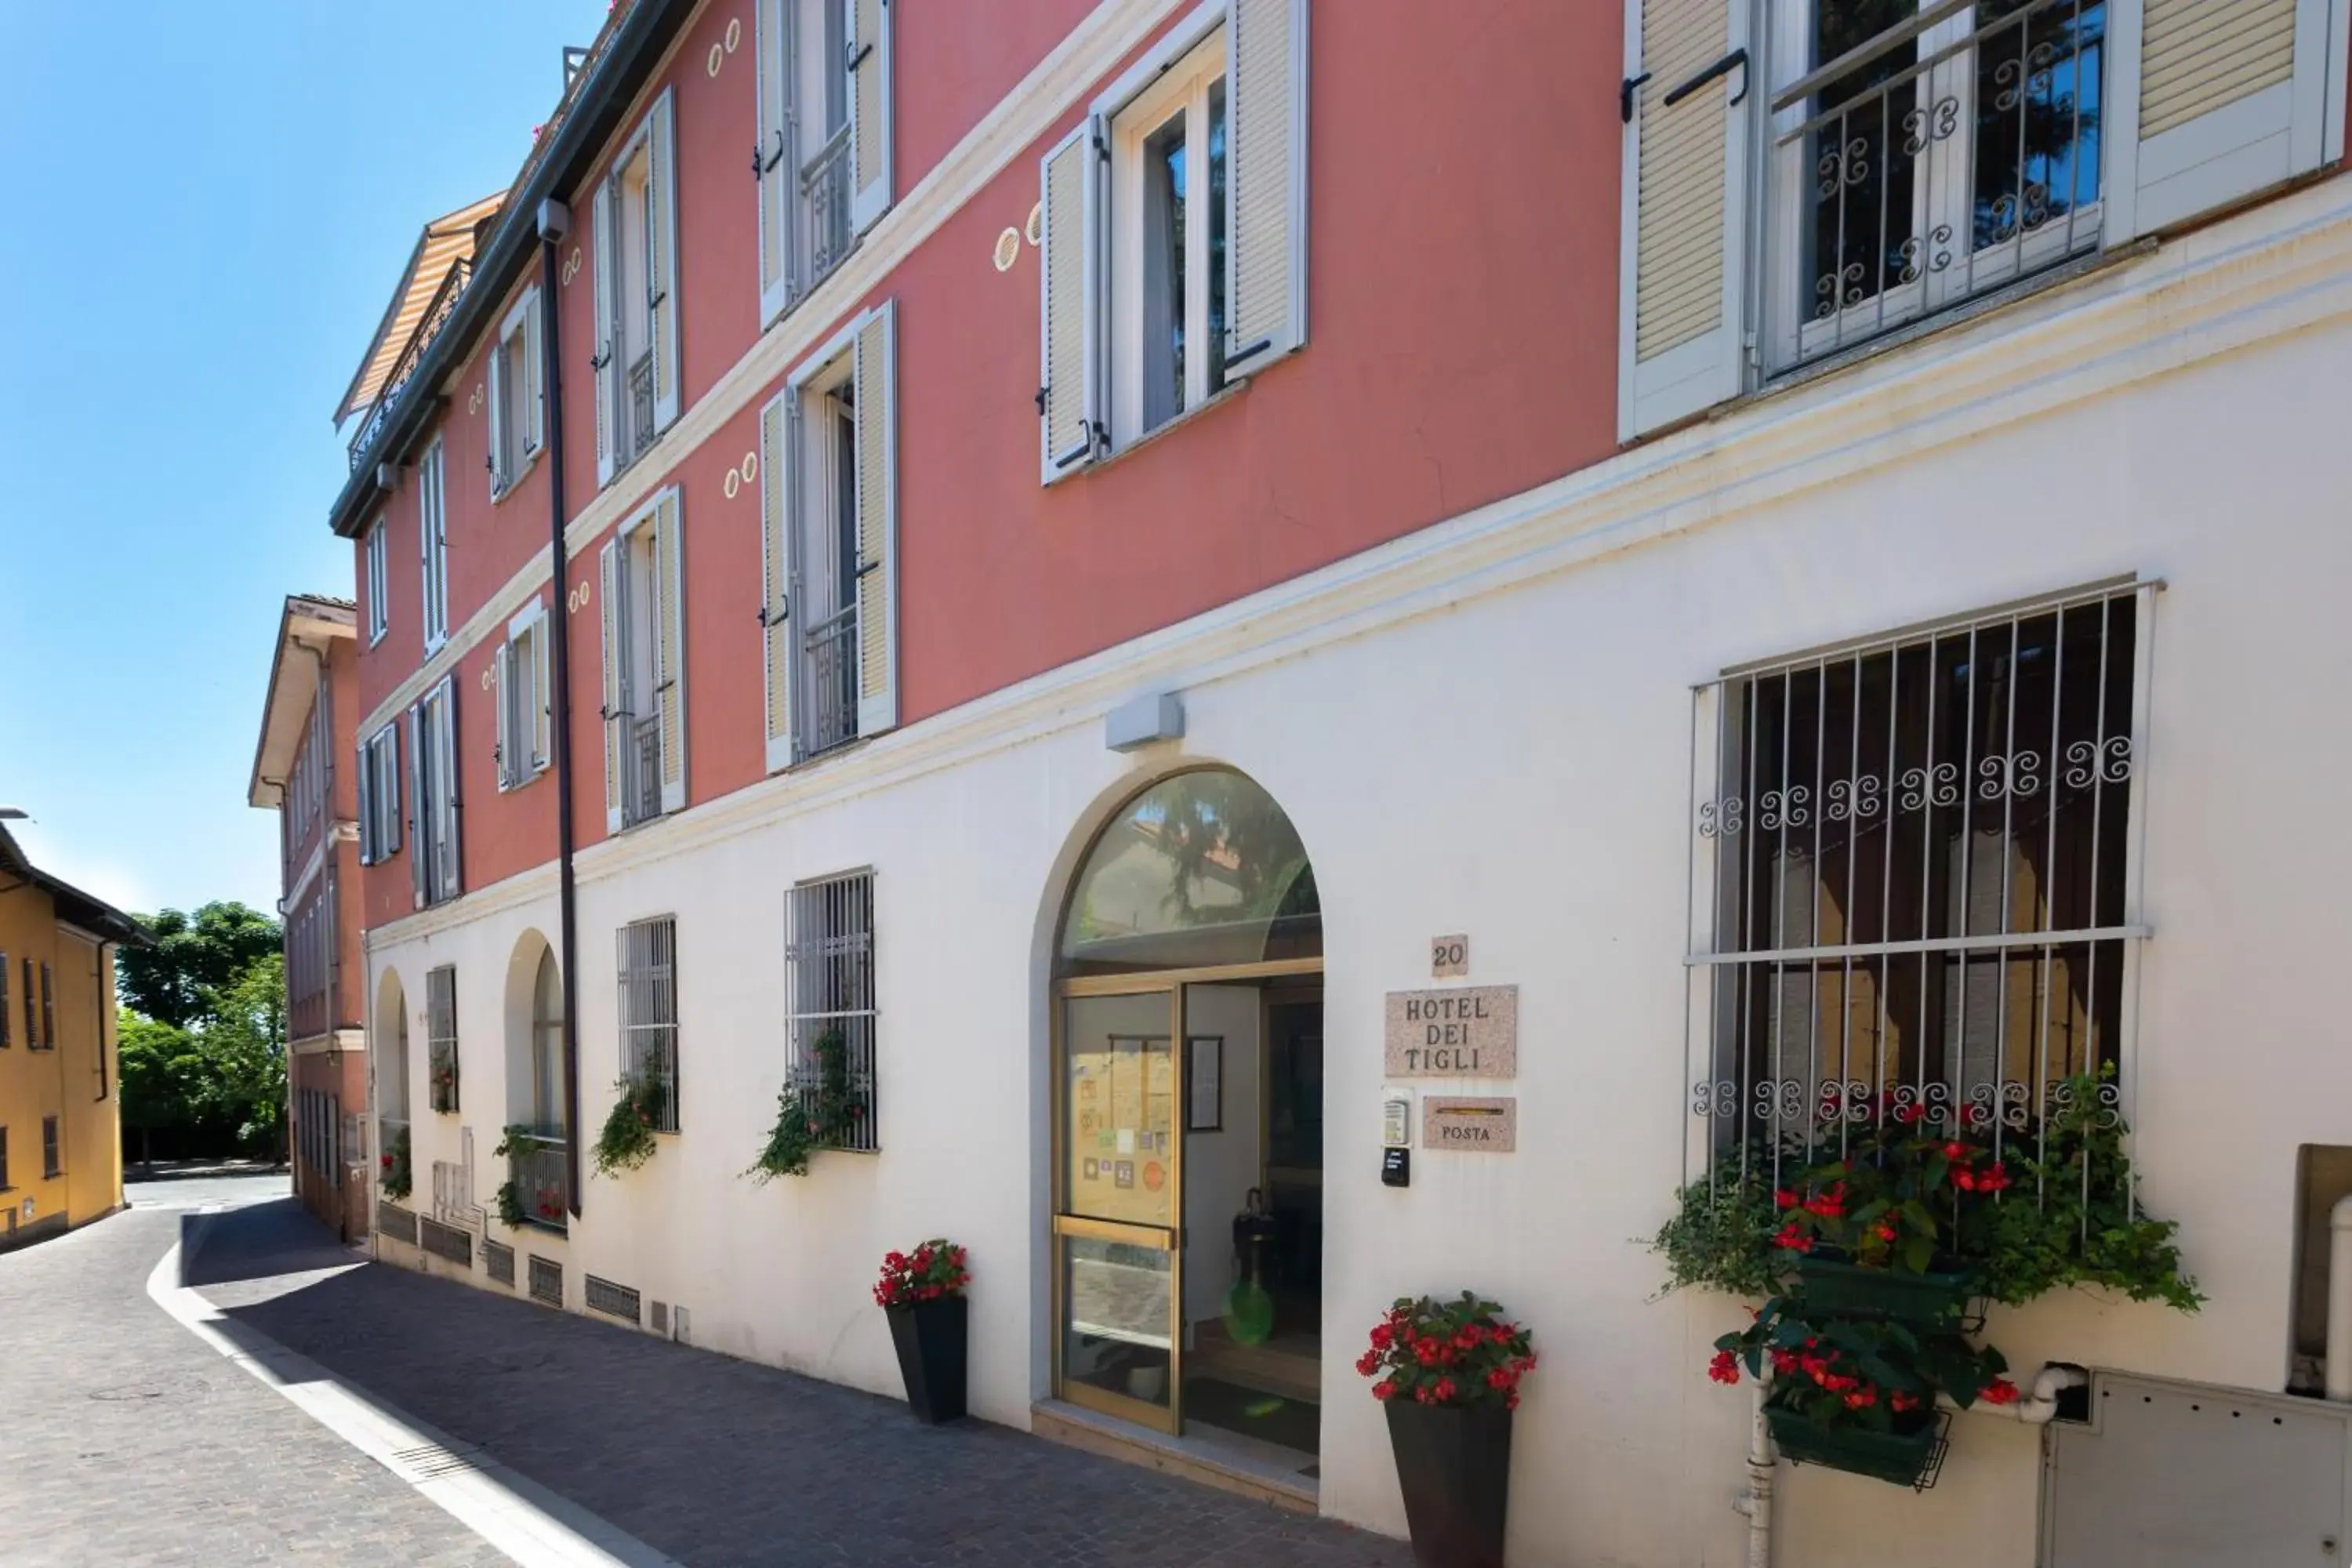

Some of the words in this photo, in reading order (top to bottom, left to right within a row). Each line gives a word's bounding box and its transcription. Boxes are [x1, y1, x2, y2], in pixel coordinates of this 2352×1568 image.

[1434, 943, 1464, 967] 20
[1406, 997, 1490, 1021] HOTEL
[1427, 1023, 1468, 1046] DEI
[1405, 1048, 1479, 1070] TIGLI
[1442, 1126, 1490, 1141] POSTA
